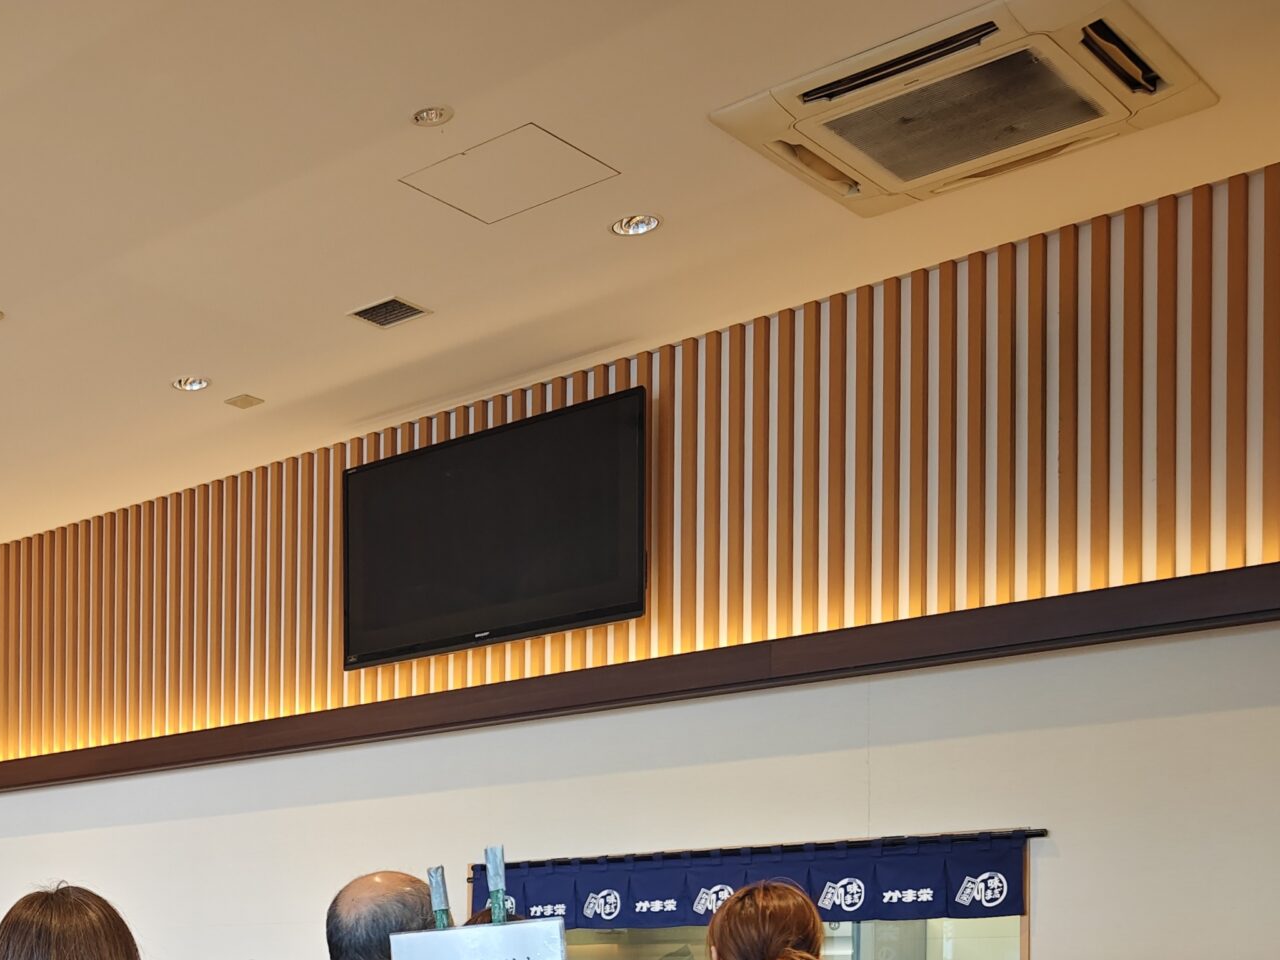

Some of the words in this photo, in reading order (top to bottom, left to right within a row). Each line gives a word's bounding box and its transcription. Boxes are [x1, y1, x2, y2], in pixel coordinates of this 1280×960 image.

[882, 887, 934, 904] かま栄
[529, 903, 567, 917] かま栄
[635, 899, 677, 912] かま栄
